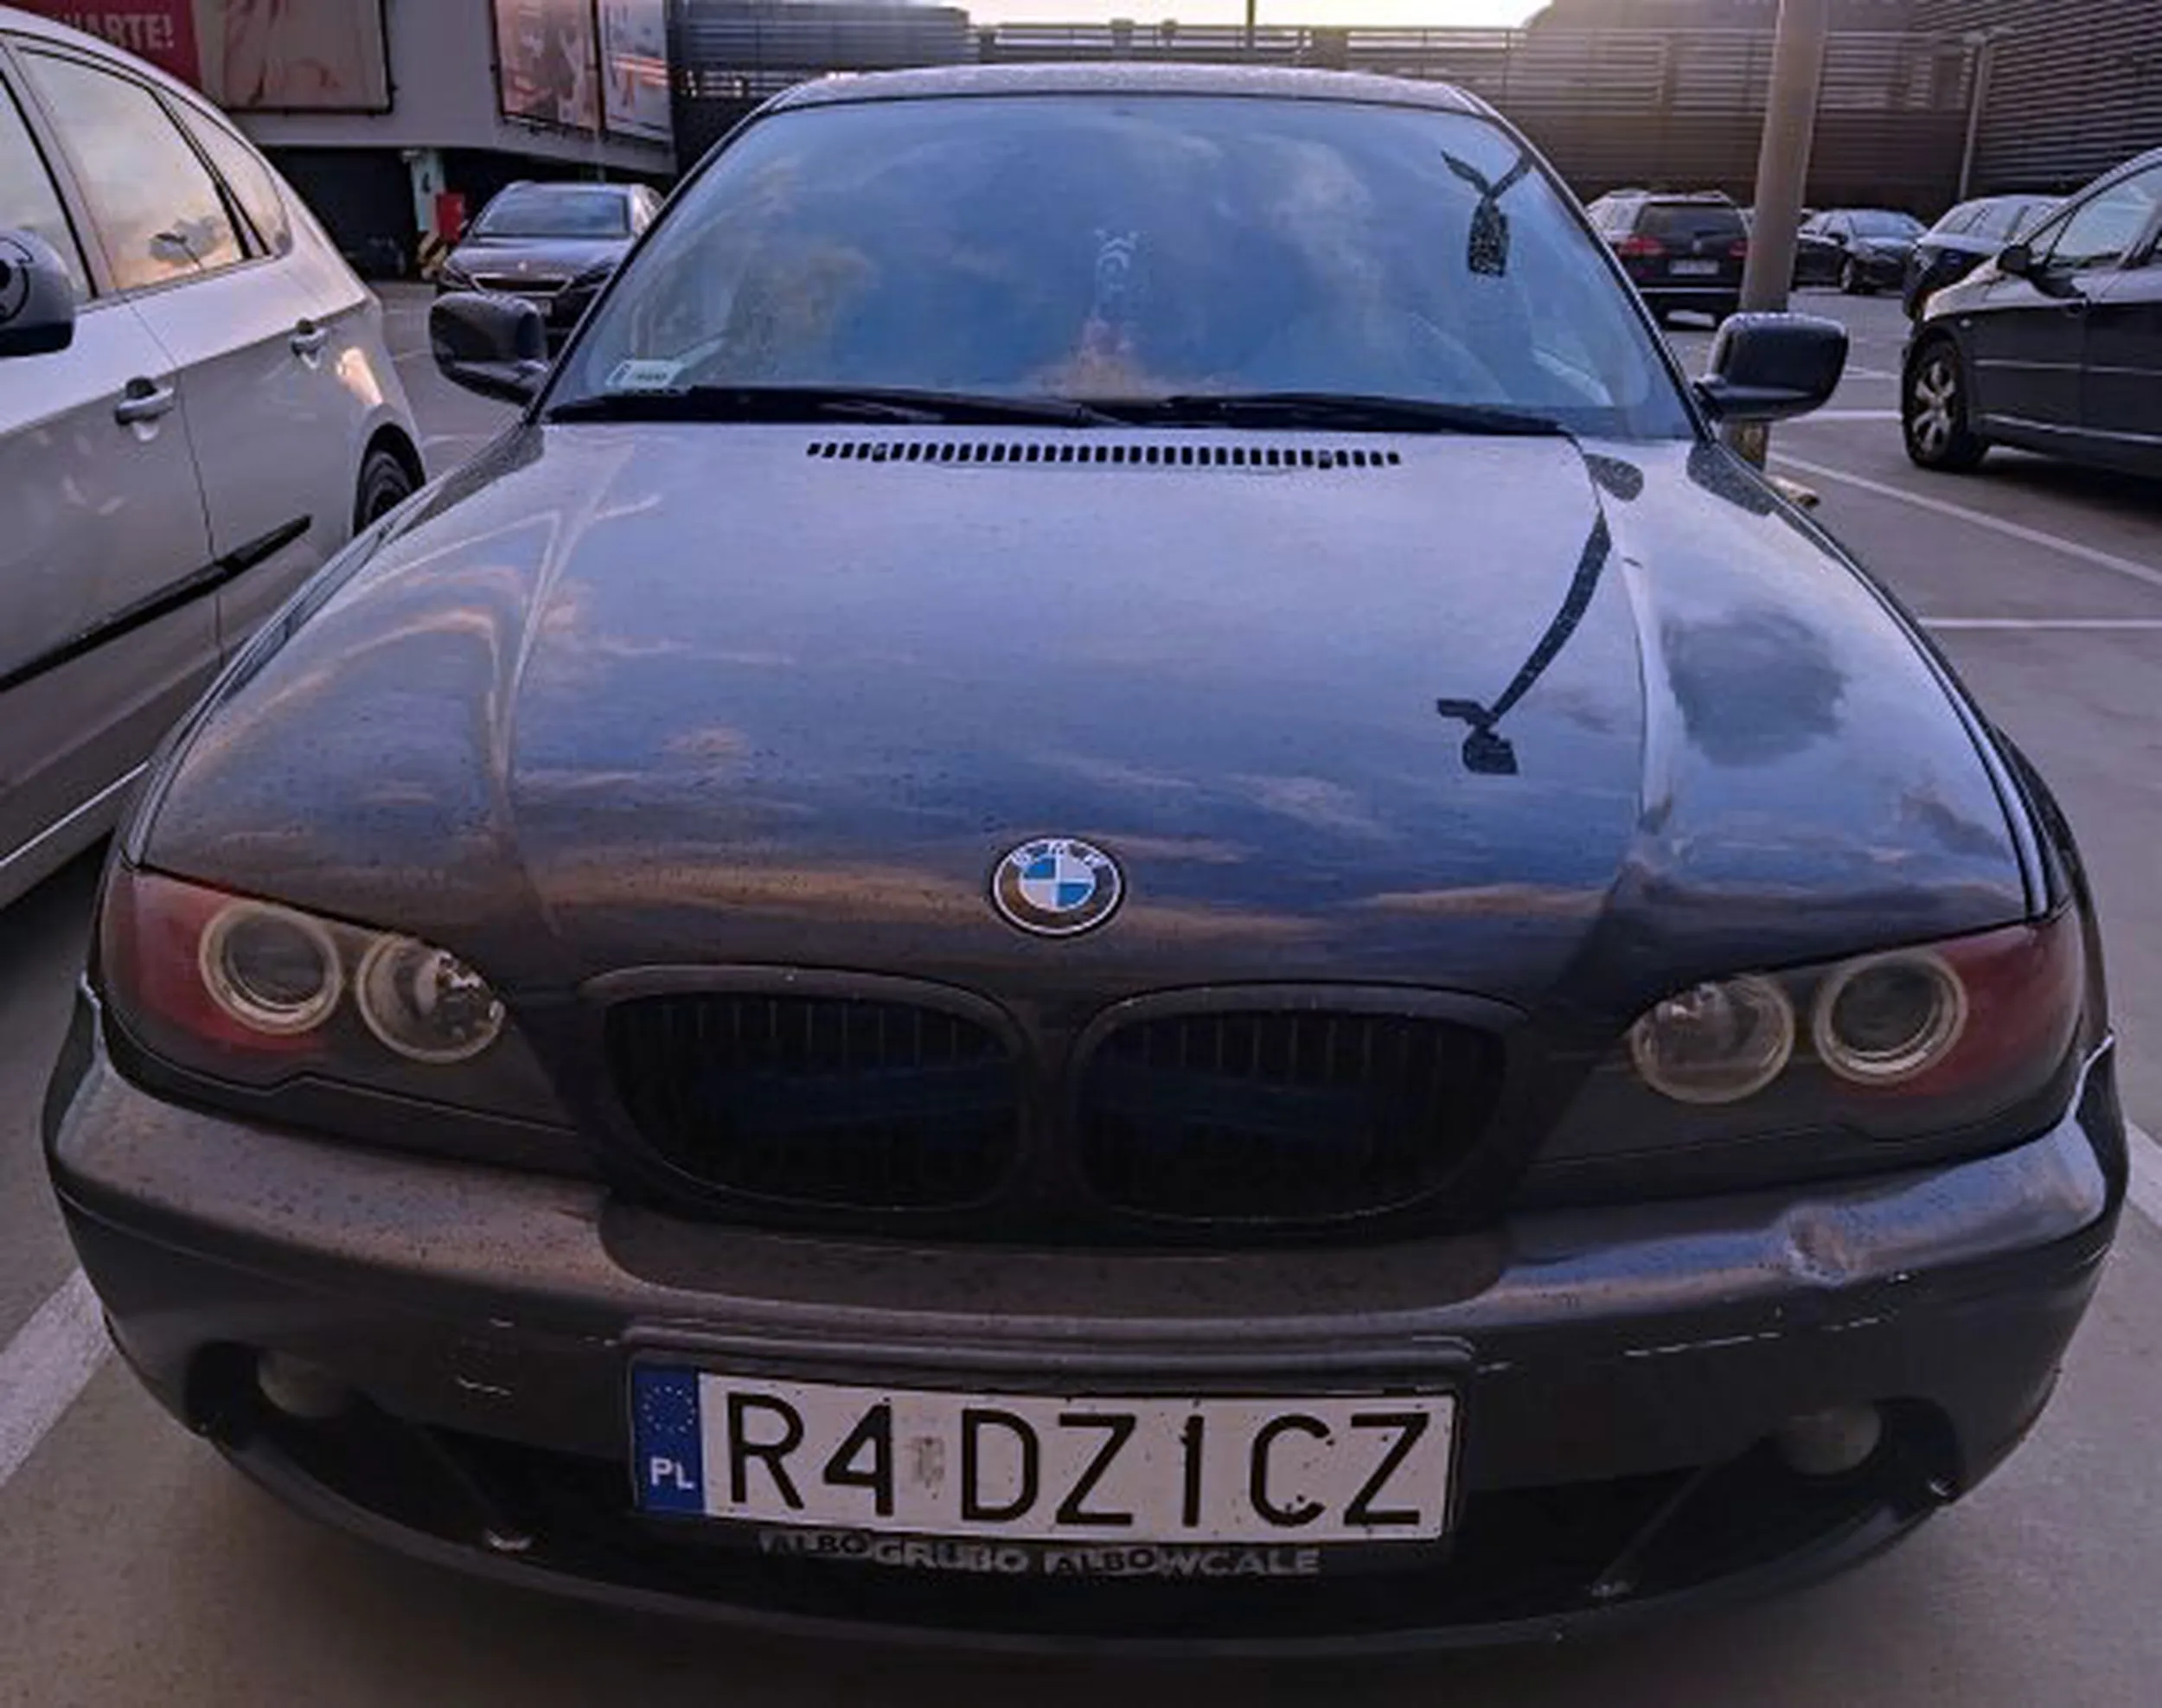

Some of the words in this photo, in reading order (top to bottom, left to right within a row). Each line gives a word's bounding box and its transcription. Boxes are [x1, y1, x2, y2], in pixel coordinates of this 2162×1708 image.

[650, 1456, 694, 1490] PL
[727, 1391, 895, 1516] R4
[962, 1408, 1430, 1527] DZICZ
